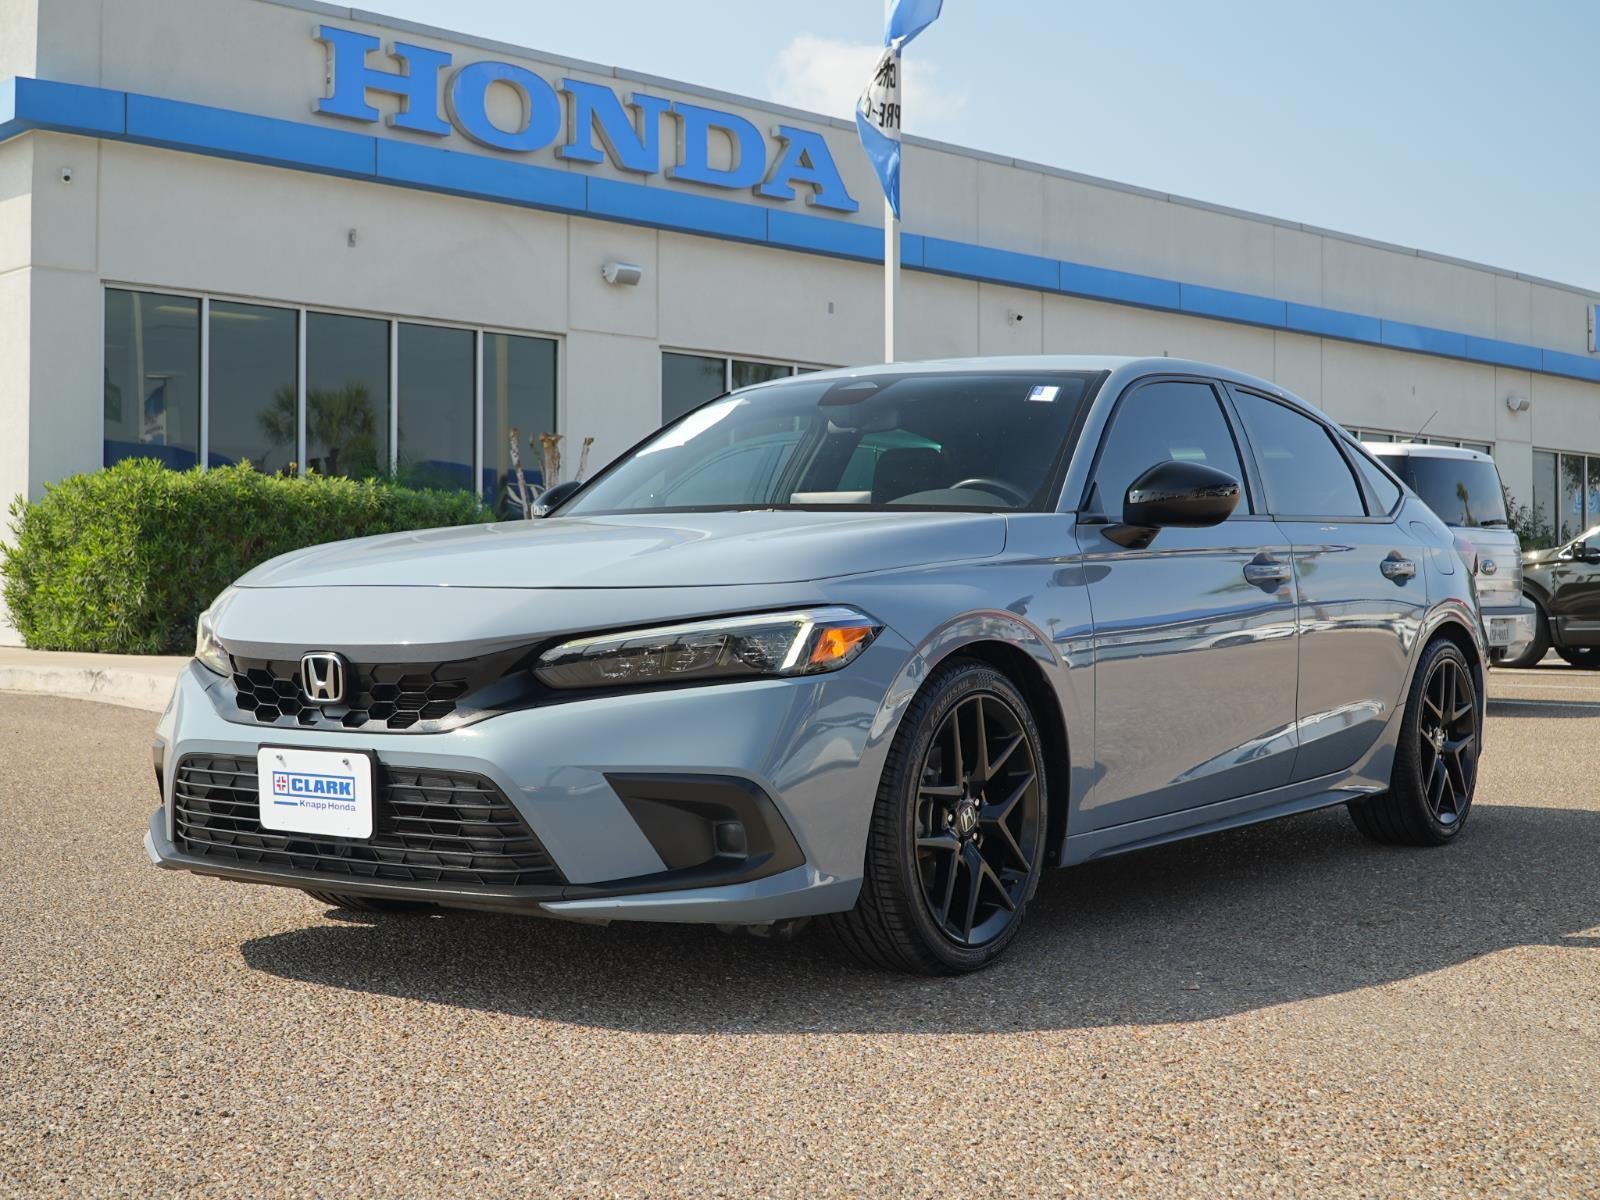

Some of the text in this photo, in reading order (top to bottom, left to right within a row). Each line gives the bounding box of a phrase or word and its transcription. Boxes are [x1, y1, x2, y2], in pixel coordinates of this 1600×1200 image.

[313, 25, 859, 212] HONDA
[291, 778, 351, 796] CLARK
[299, 799, 356, 812] Knapp Honda
